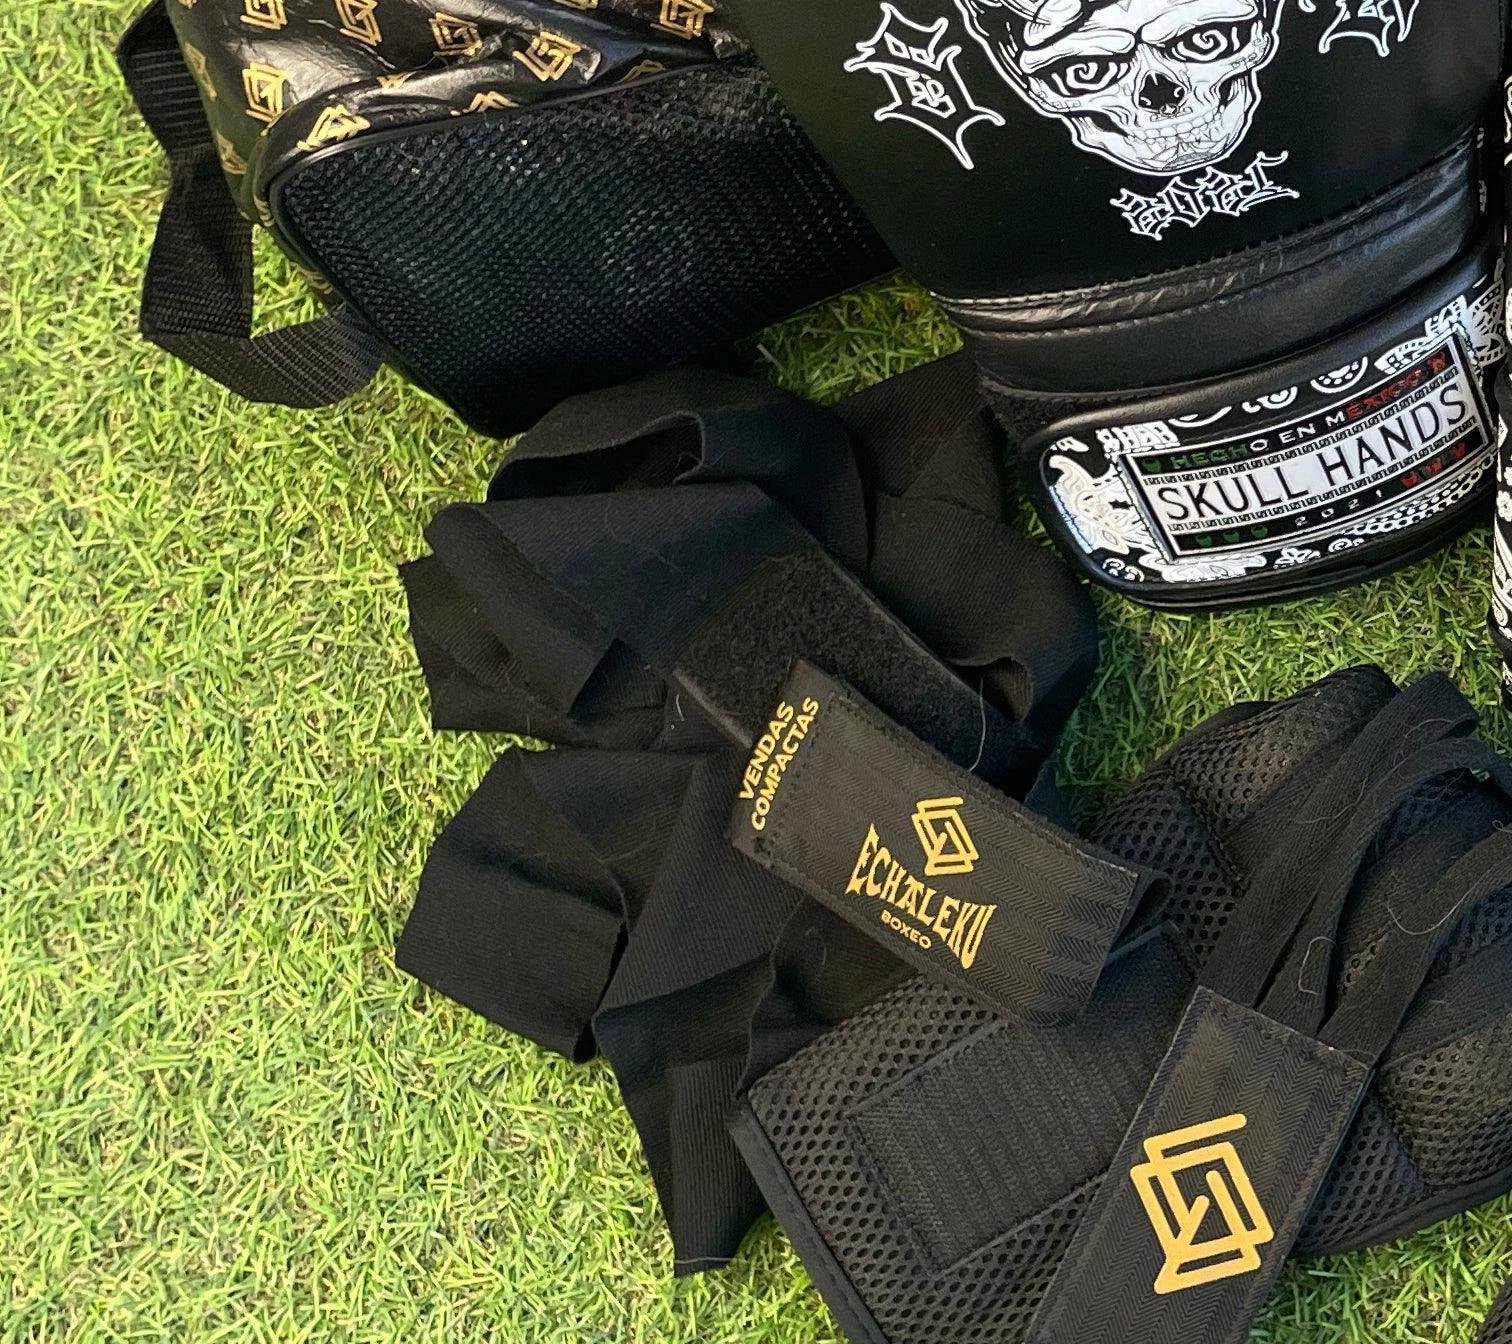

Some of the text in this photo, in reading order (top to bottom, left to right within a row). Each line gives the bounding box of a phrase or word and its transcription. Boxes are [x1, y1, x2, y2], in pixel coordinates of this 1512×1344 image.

[1158, 383, 1465, 520] SKULL HANDS
[1170, 439, 1269, 470] HECHO
[1279, 423, 1316, 443] EN
[738, 701, 794, 799] VENDAS
[751, 697, 820, 830] COMPACTAS
[845, 823, 997, 969] ECHALEKU
[880, 910, 932, 950] BOXEO
